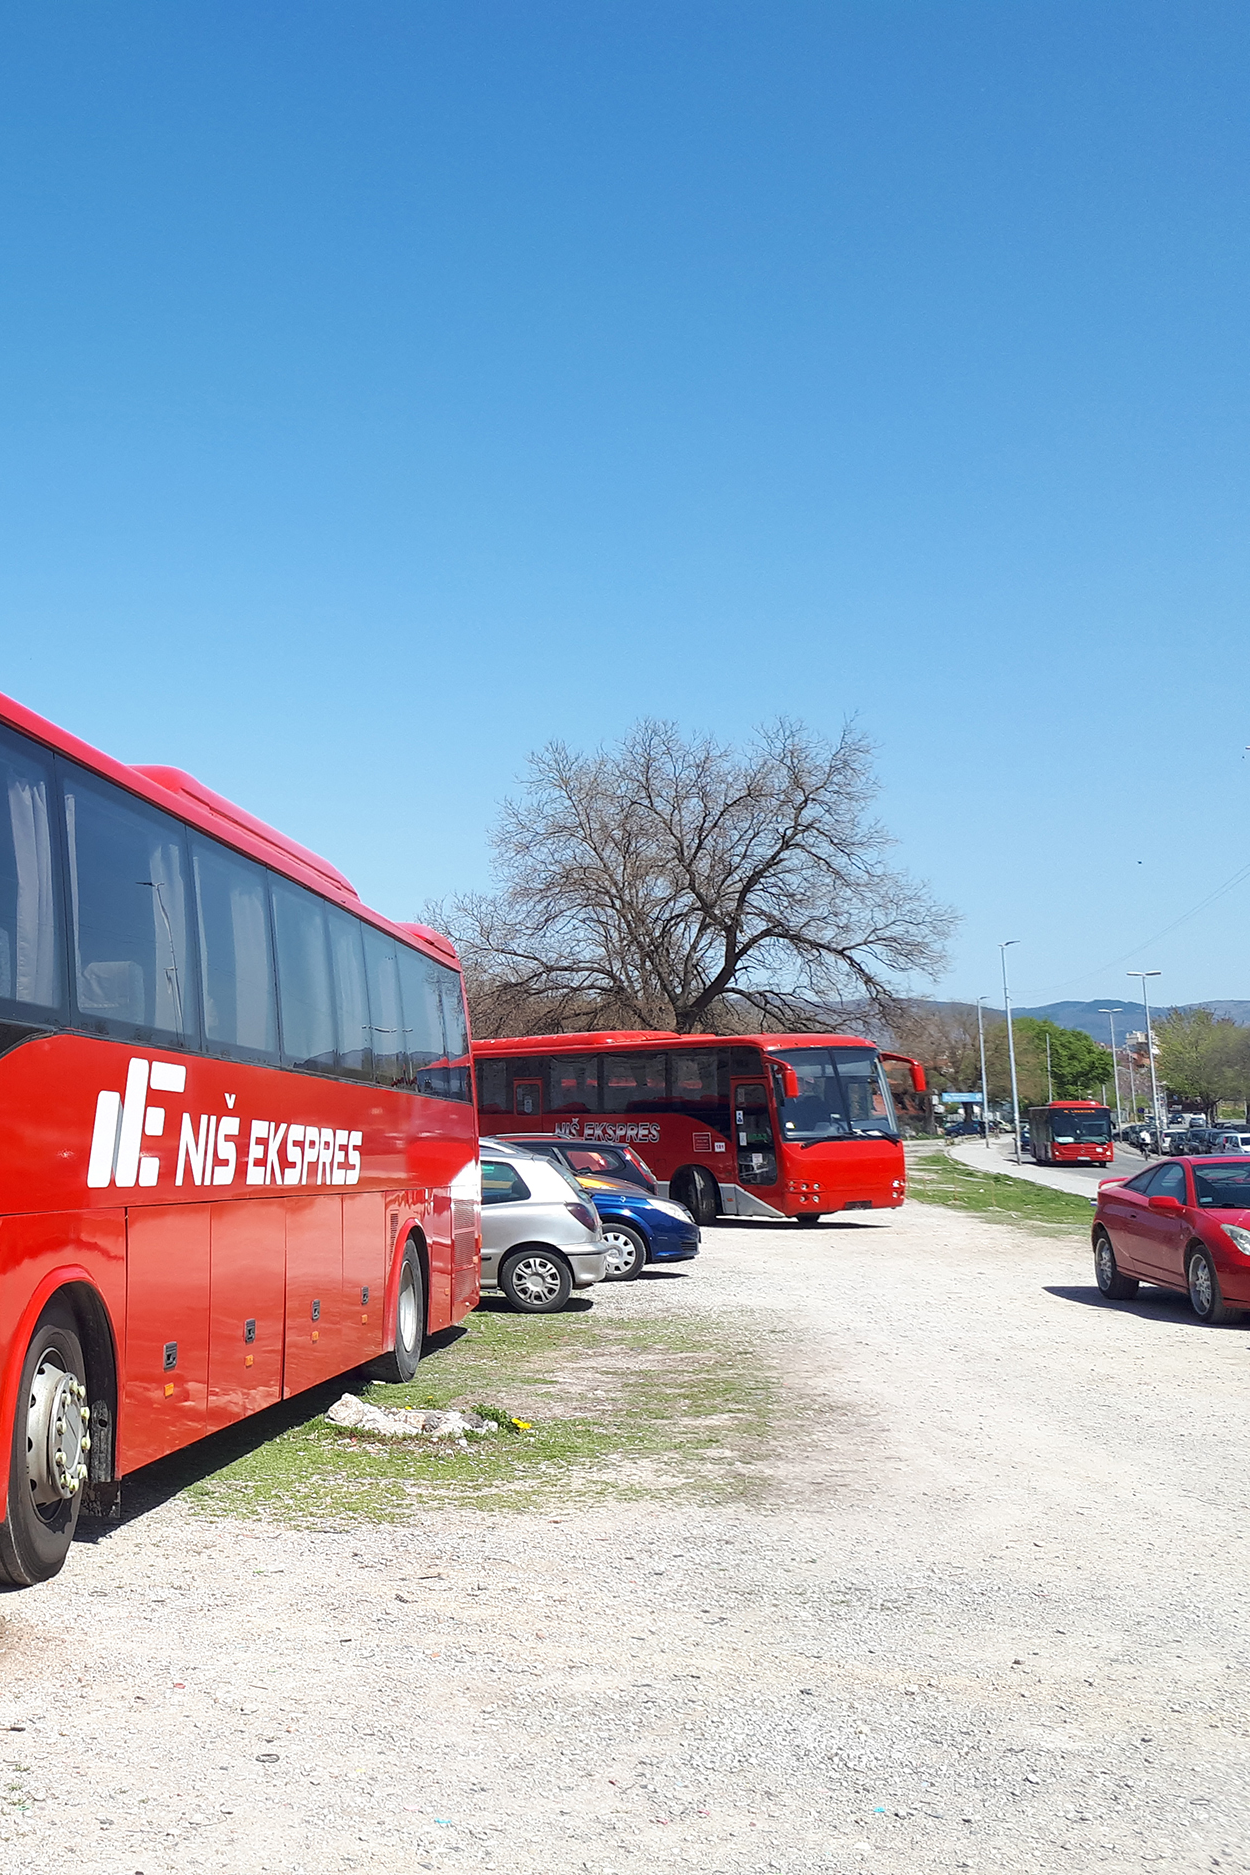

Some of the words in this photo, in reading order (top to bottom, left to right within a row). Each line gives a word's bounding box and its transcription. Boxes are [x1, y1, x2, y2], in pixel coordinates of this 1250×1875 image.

[175, 1092, 240, 1187] NIŠ
[246, 1120, 363, 1186] EKSPRES
[583, 1122, 661, 1143] EKSPRES
